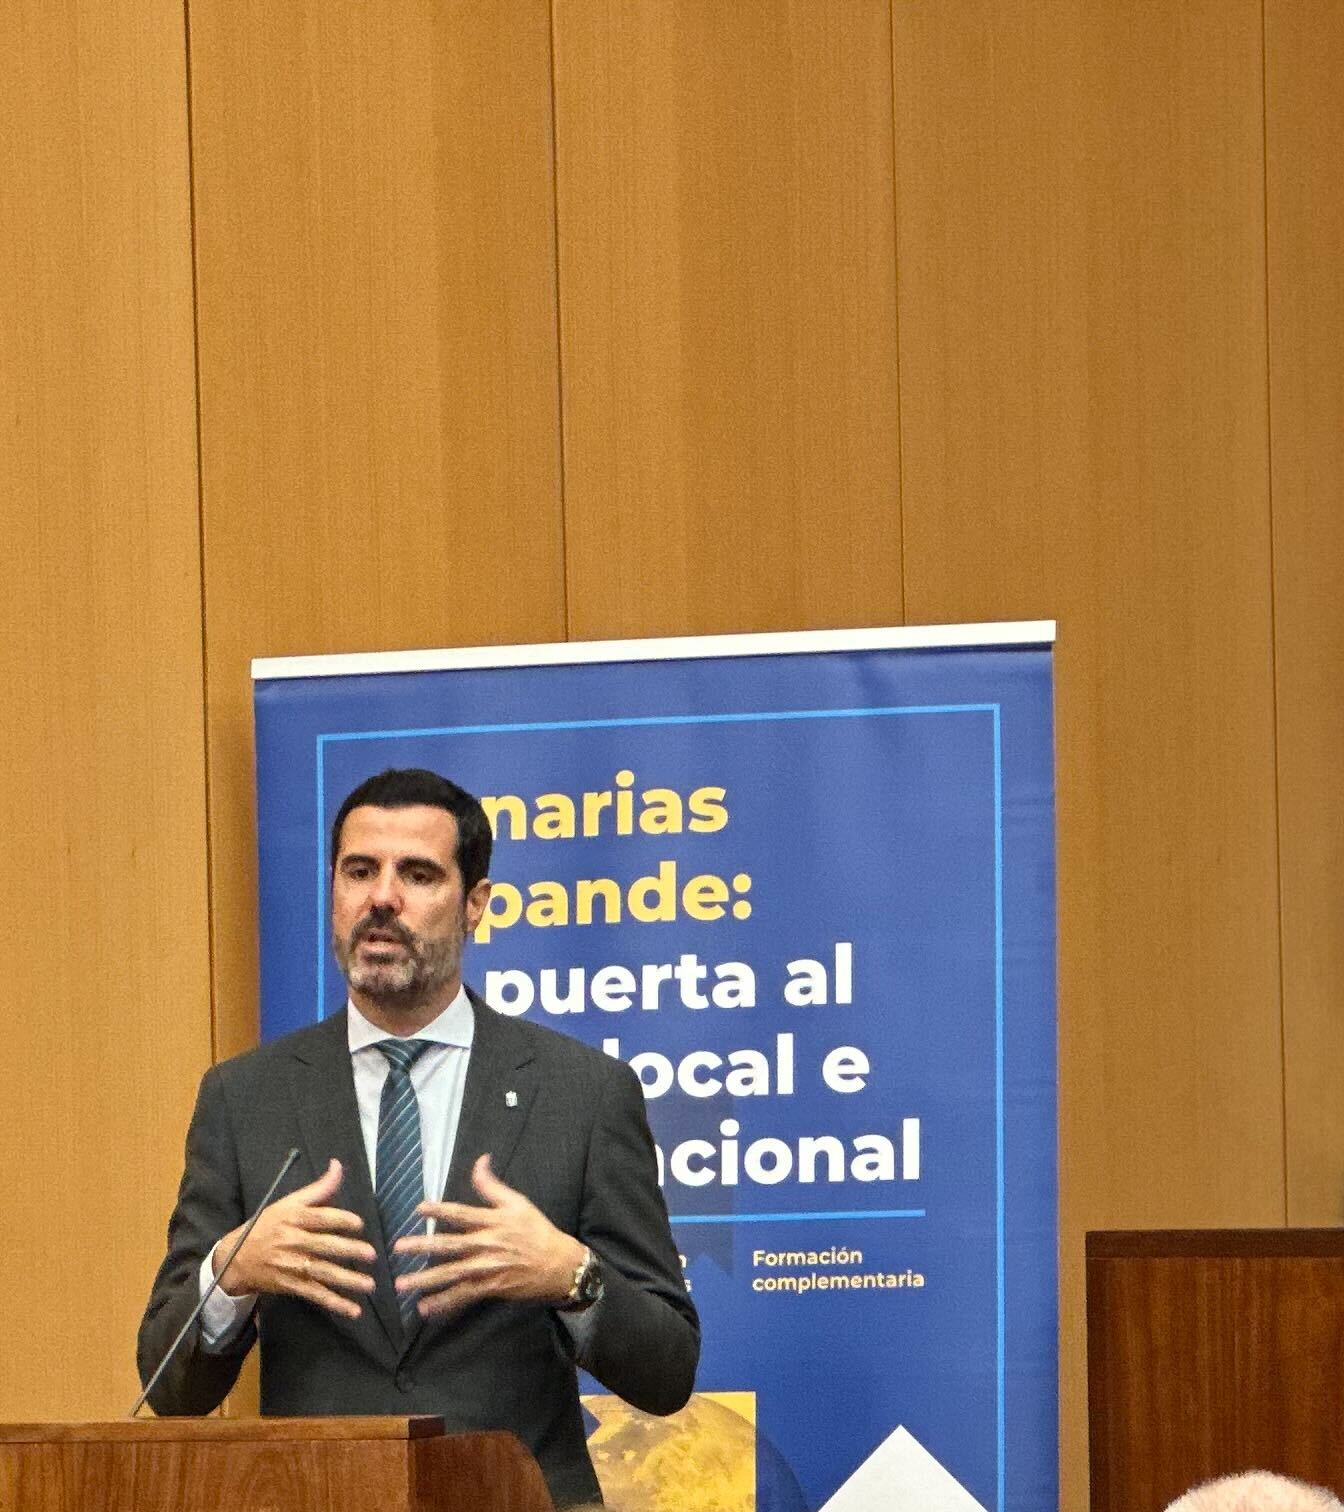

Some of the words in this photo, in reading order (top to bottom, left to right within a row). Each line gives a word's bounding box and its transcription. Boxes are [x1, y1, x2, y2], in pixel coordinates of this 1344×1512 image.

[480, 769, 729, 840] narias
[474, 860, 752, 944] pande:
[485, 953, 756, 1016] puerta
[784, 942, 853, 1006] al
[822, 1043, 870, 1093] e
[752, 1246, 863, 1267] Formación
[752, 1269, 925, 1294] complementaria
